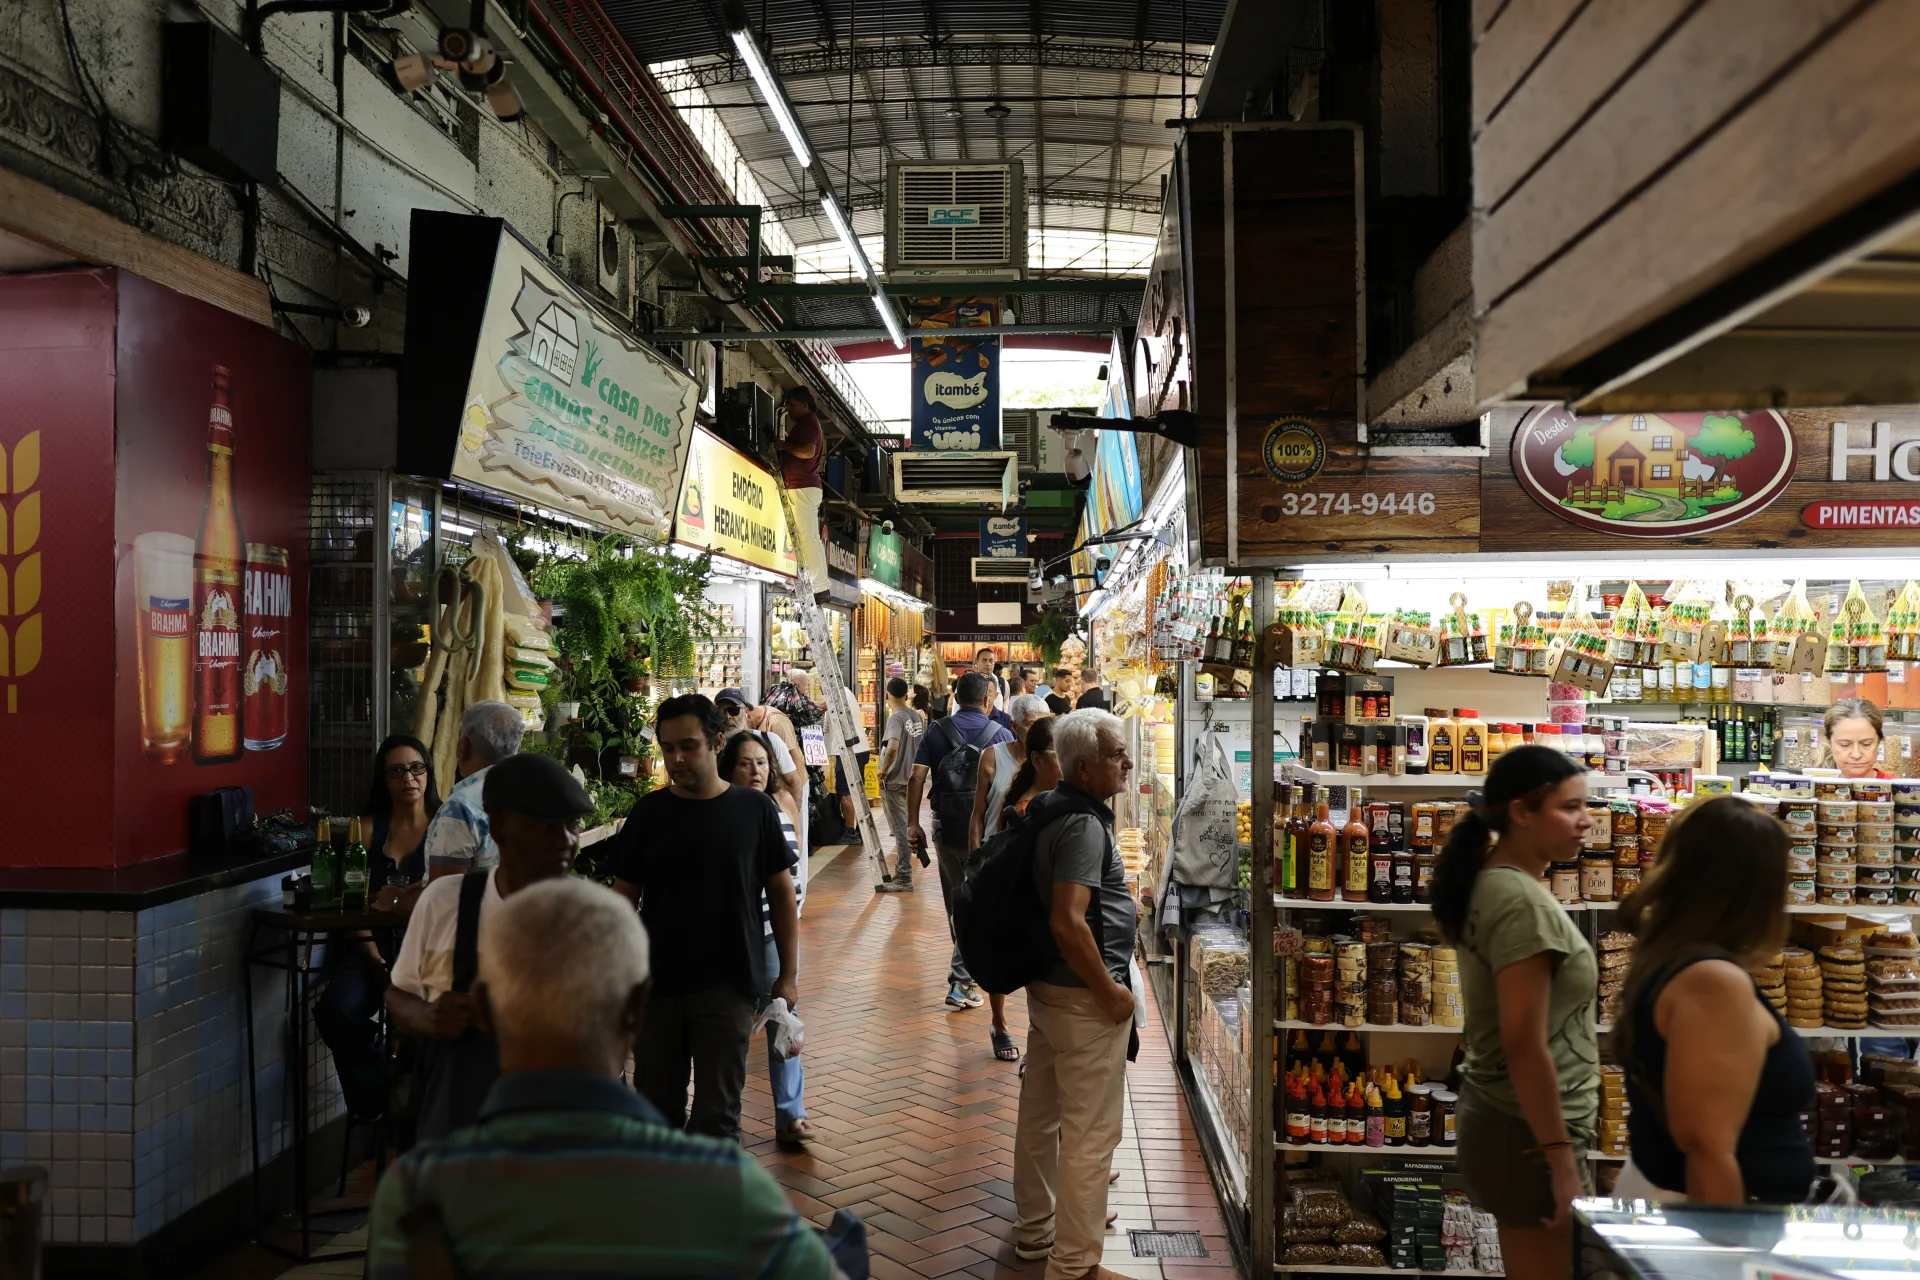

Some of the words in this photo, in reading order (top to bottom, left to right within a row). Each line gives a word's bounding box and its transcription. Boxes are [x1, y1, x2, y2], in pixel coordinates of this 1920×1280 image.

[933, 209, 975, 218] ACF
[935, 383, 980, 395] itambé
[599, 377, 640, 420] CASA
[643, 404, 671, 438] DAS
[524, 376, 592, 430] ERVAS
[596, 415, 609, 439] &
[613, 427, 666, 467] RAÍZES
[942, 415, 964, 424] únicos
[1533, 417, 1569, 445] Desde
[528, 417, 662, 488] MEDICINAIS
[1277, 444, 1312, 456] 100%
[732, 471, 763, 510] EMPÓRIO
[1282, 492, 1436, 516] 3274-9446
[993, 522, 1016, 530] itambé
[1819, 505, 1920, 526] PIMENTAS
[714, 505, 749, 548] HERANÇA
[751, 521, 777, 553] MINEIRA
[151, 611, 187, 633] BRAHMA
[252, 626, 280, 639] Chopp
[200, 632, 239, 656] BRAHMA
[1591, 828, 1608, 836] DOM
